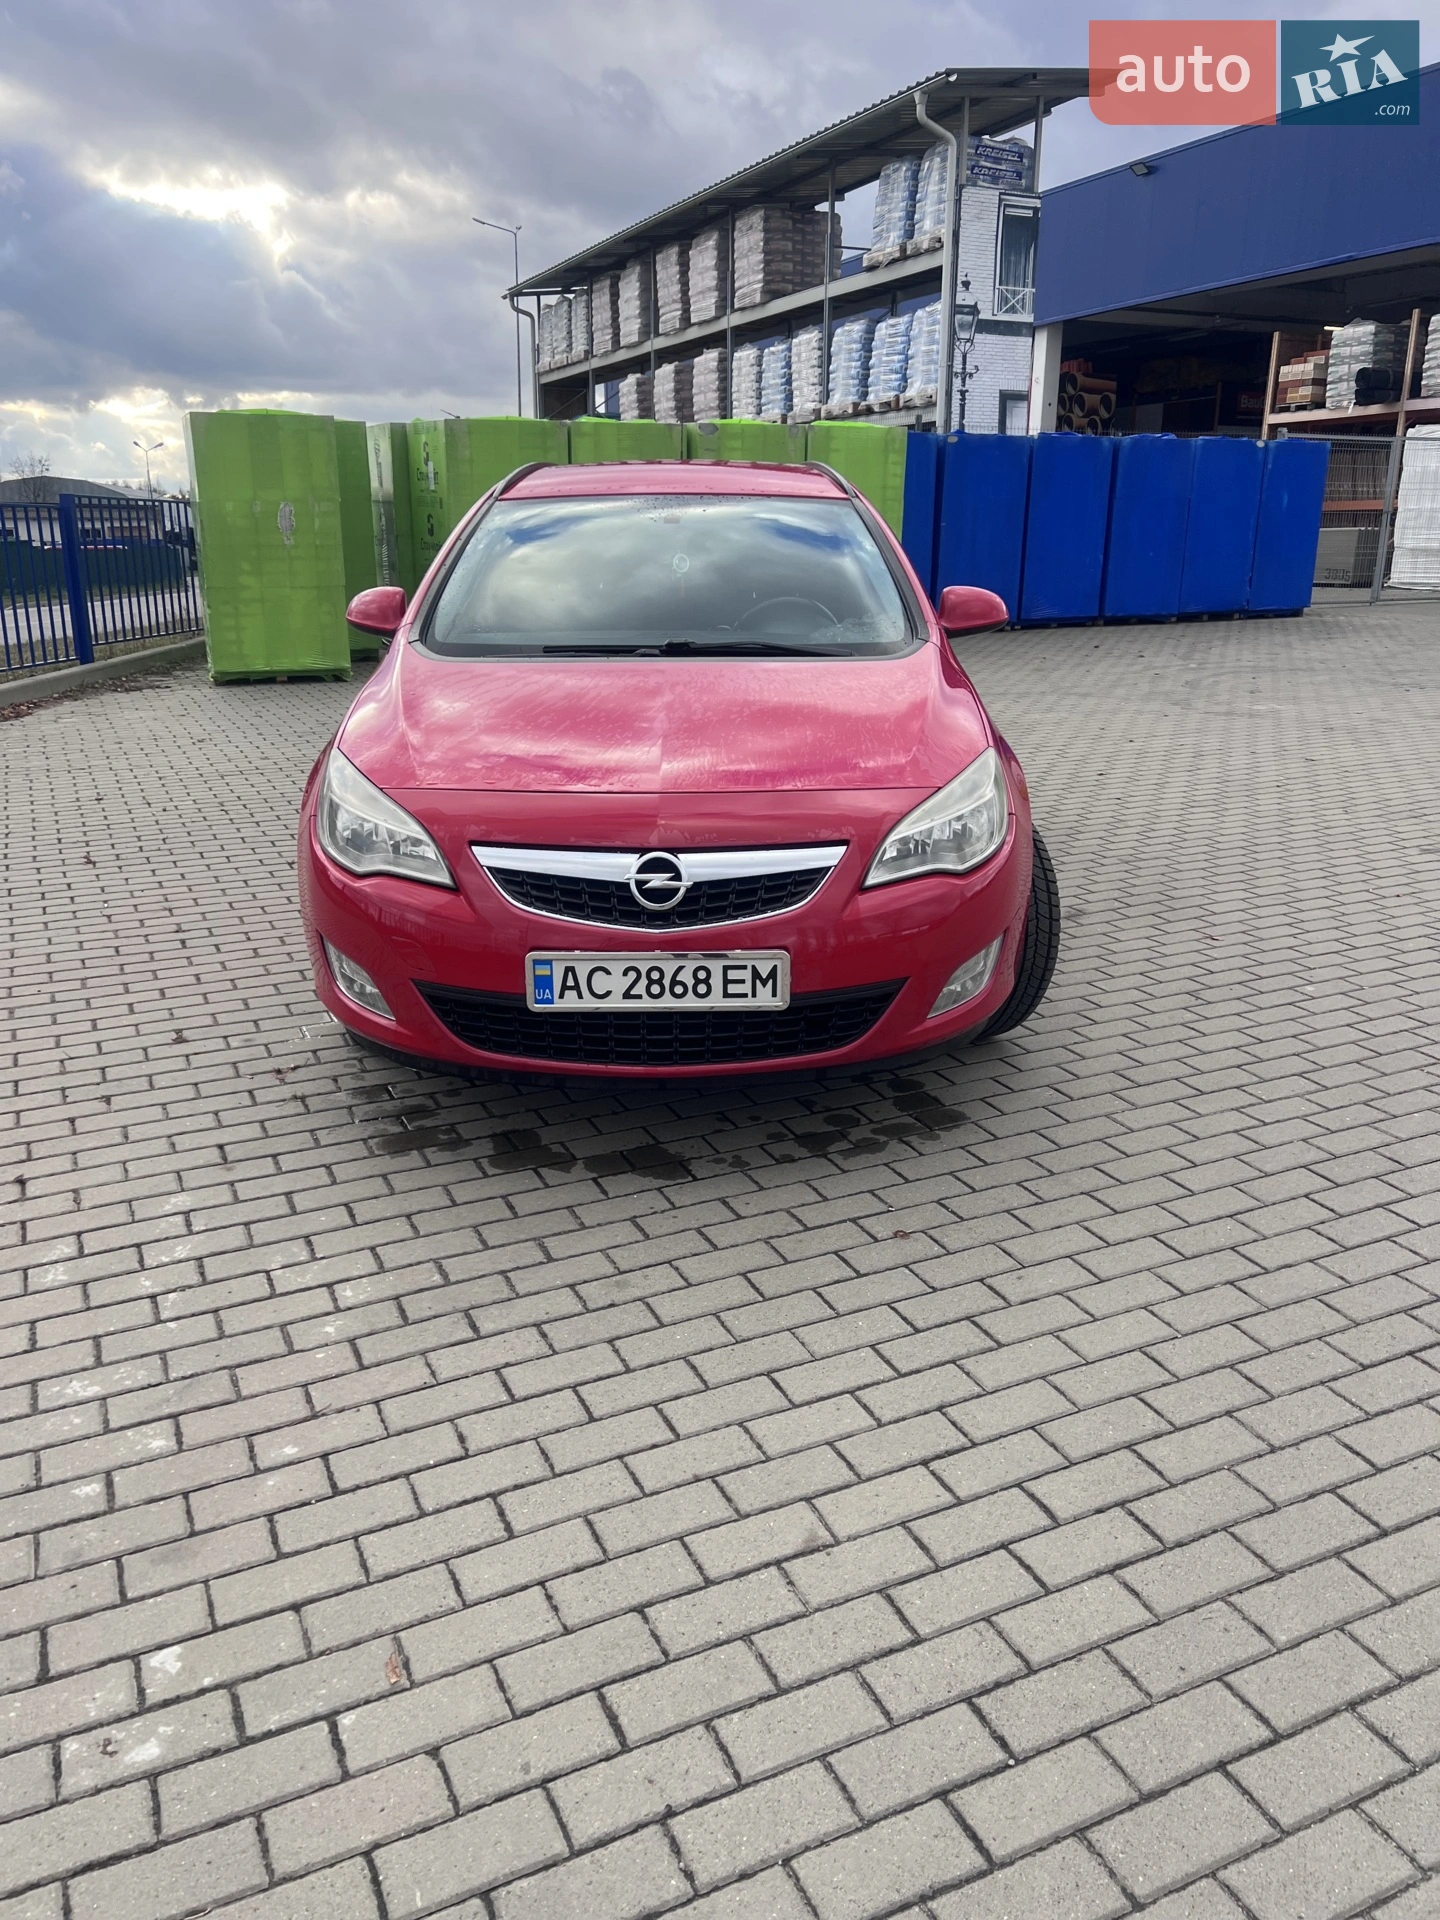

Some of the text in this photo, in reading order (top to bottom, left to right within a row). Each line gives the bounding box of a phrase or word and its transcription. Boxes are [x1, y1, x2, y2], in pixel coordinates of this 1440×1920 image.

[976, 146, 1021, 161] KREISEL
[972, 166, 1020, 180] KREISEL
[558, 964, 778, 1000] AC 2868 EM
[535, 989, 552, 1000] UA
